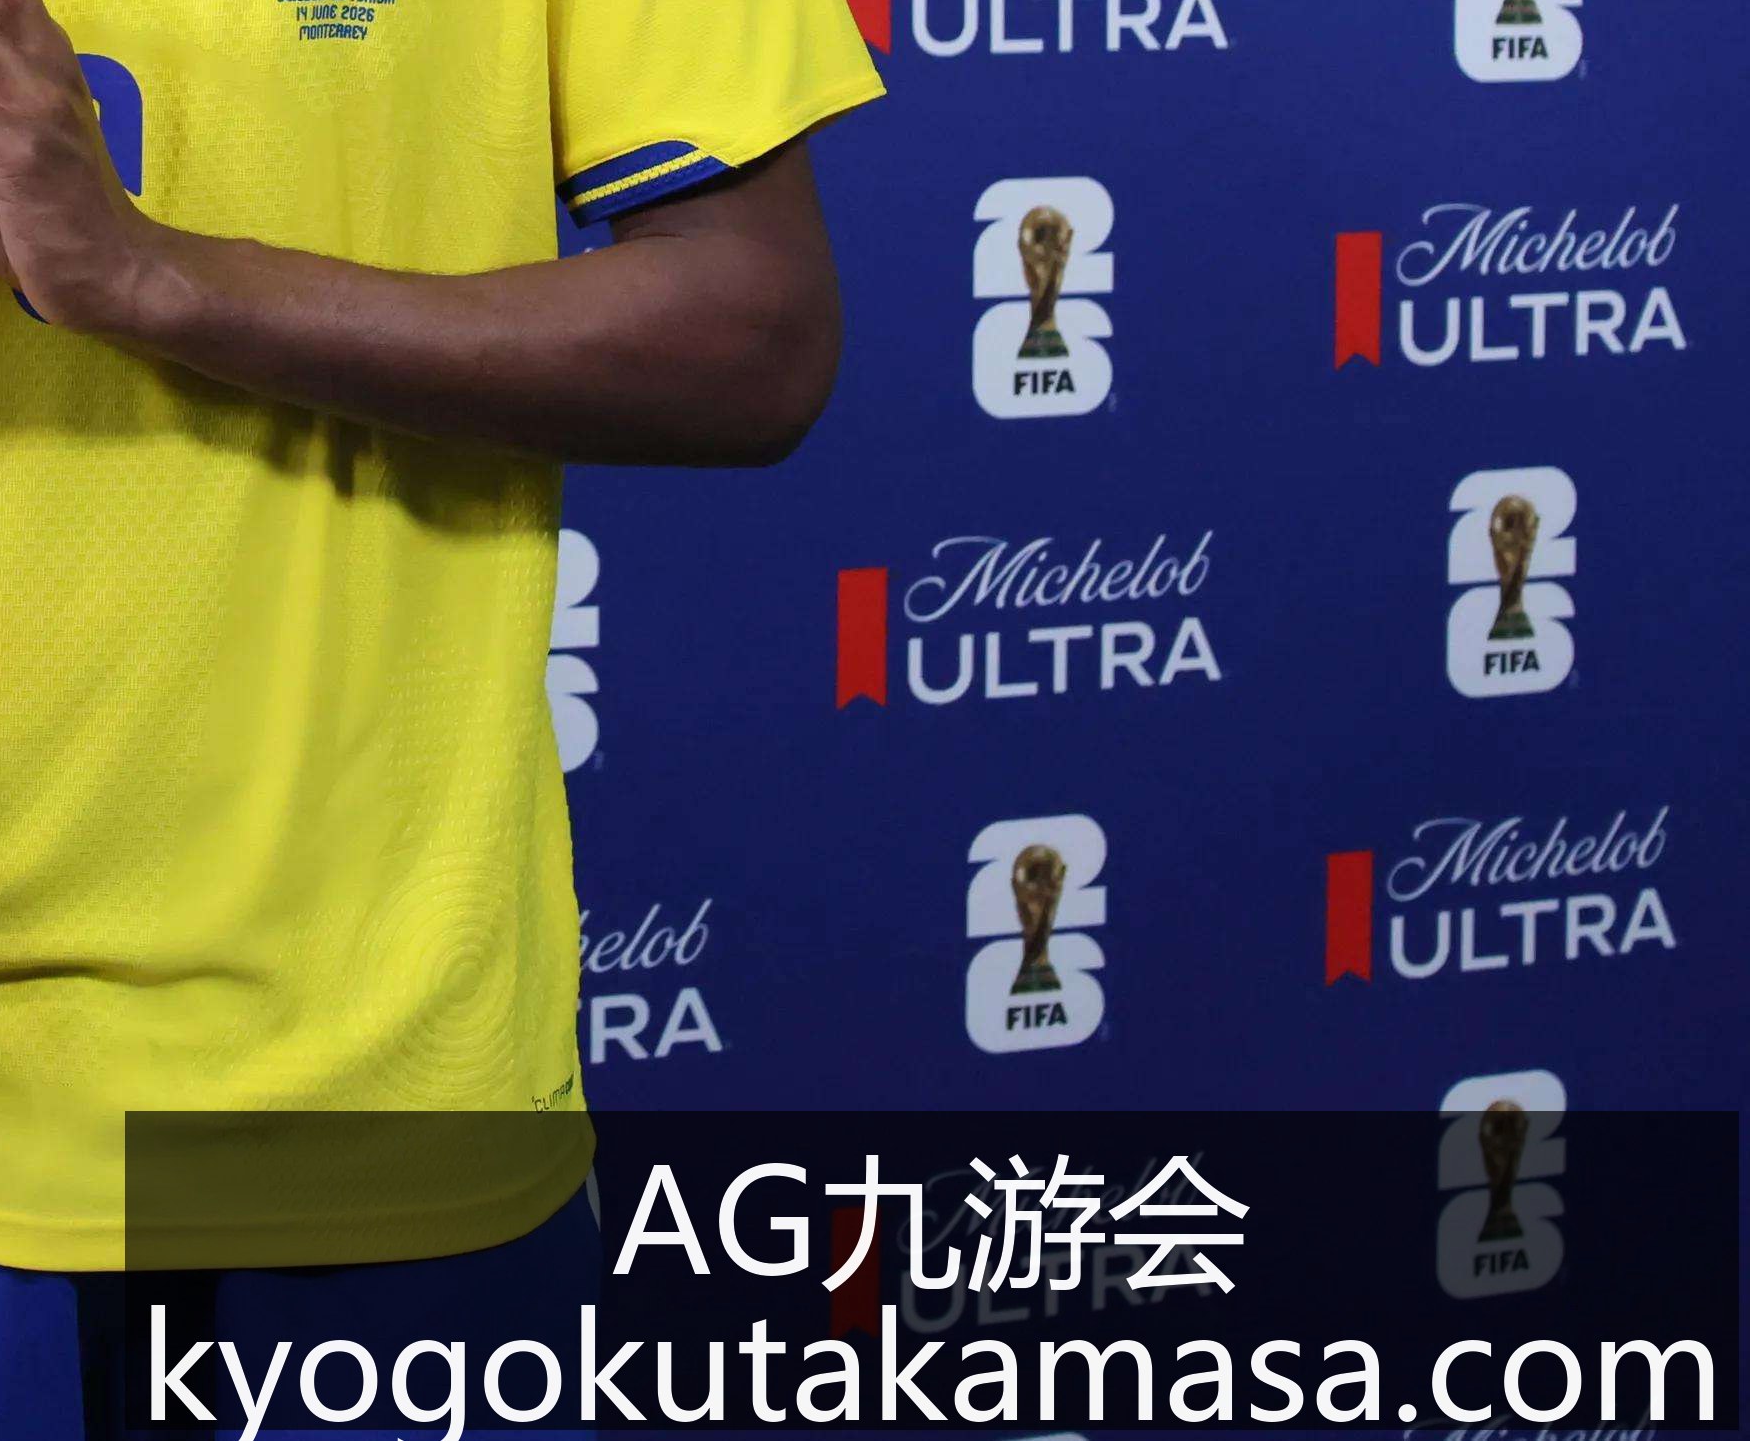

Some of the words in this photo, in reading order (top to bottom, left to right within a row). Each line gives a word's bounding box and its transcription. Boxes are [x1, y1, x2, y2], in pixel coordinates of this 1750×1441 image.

[296, 6, 307, 21] 14
[311, 4, 338, 21] JUNE
[341, 6, 375, 22] 2026
[299, 24, 368, 41] MONTERREY
[1493, 37, 1547, 59] FIFA
[1397, 204, 1678, 286] Michelob
[1400, 287, 1686, 366] ULTRA
[1014, 370, 1074, 395] FIFA
[905, 531, 1212, 622] Michelob
[908, 617, 1221, 704] ULTRA
[1484, 651, 1539, 675] FIFA
[1388, 806, 1668, 901] Michelob
[1391, 888, 1676, 978] ULTRA
[1007, 1003, 1066, 1030] FIFA
[1474, 1249, 1529, 1276] FIFA
